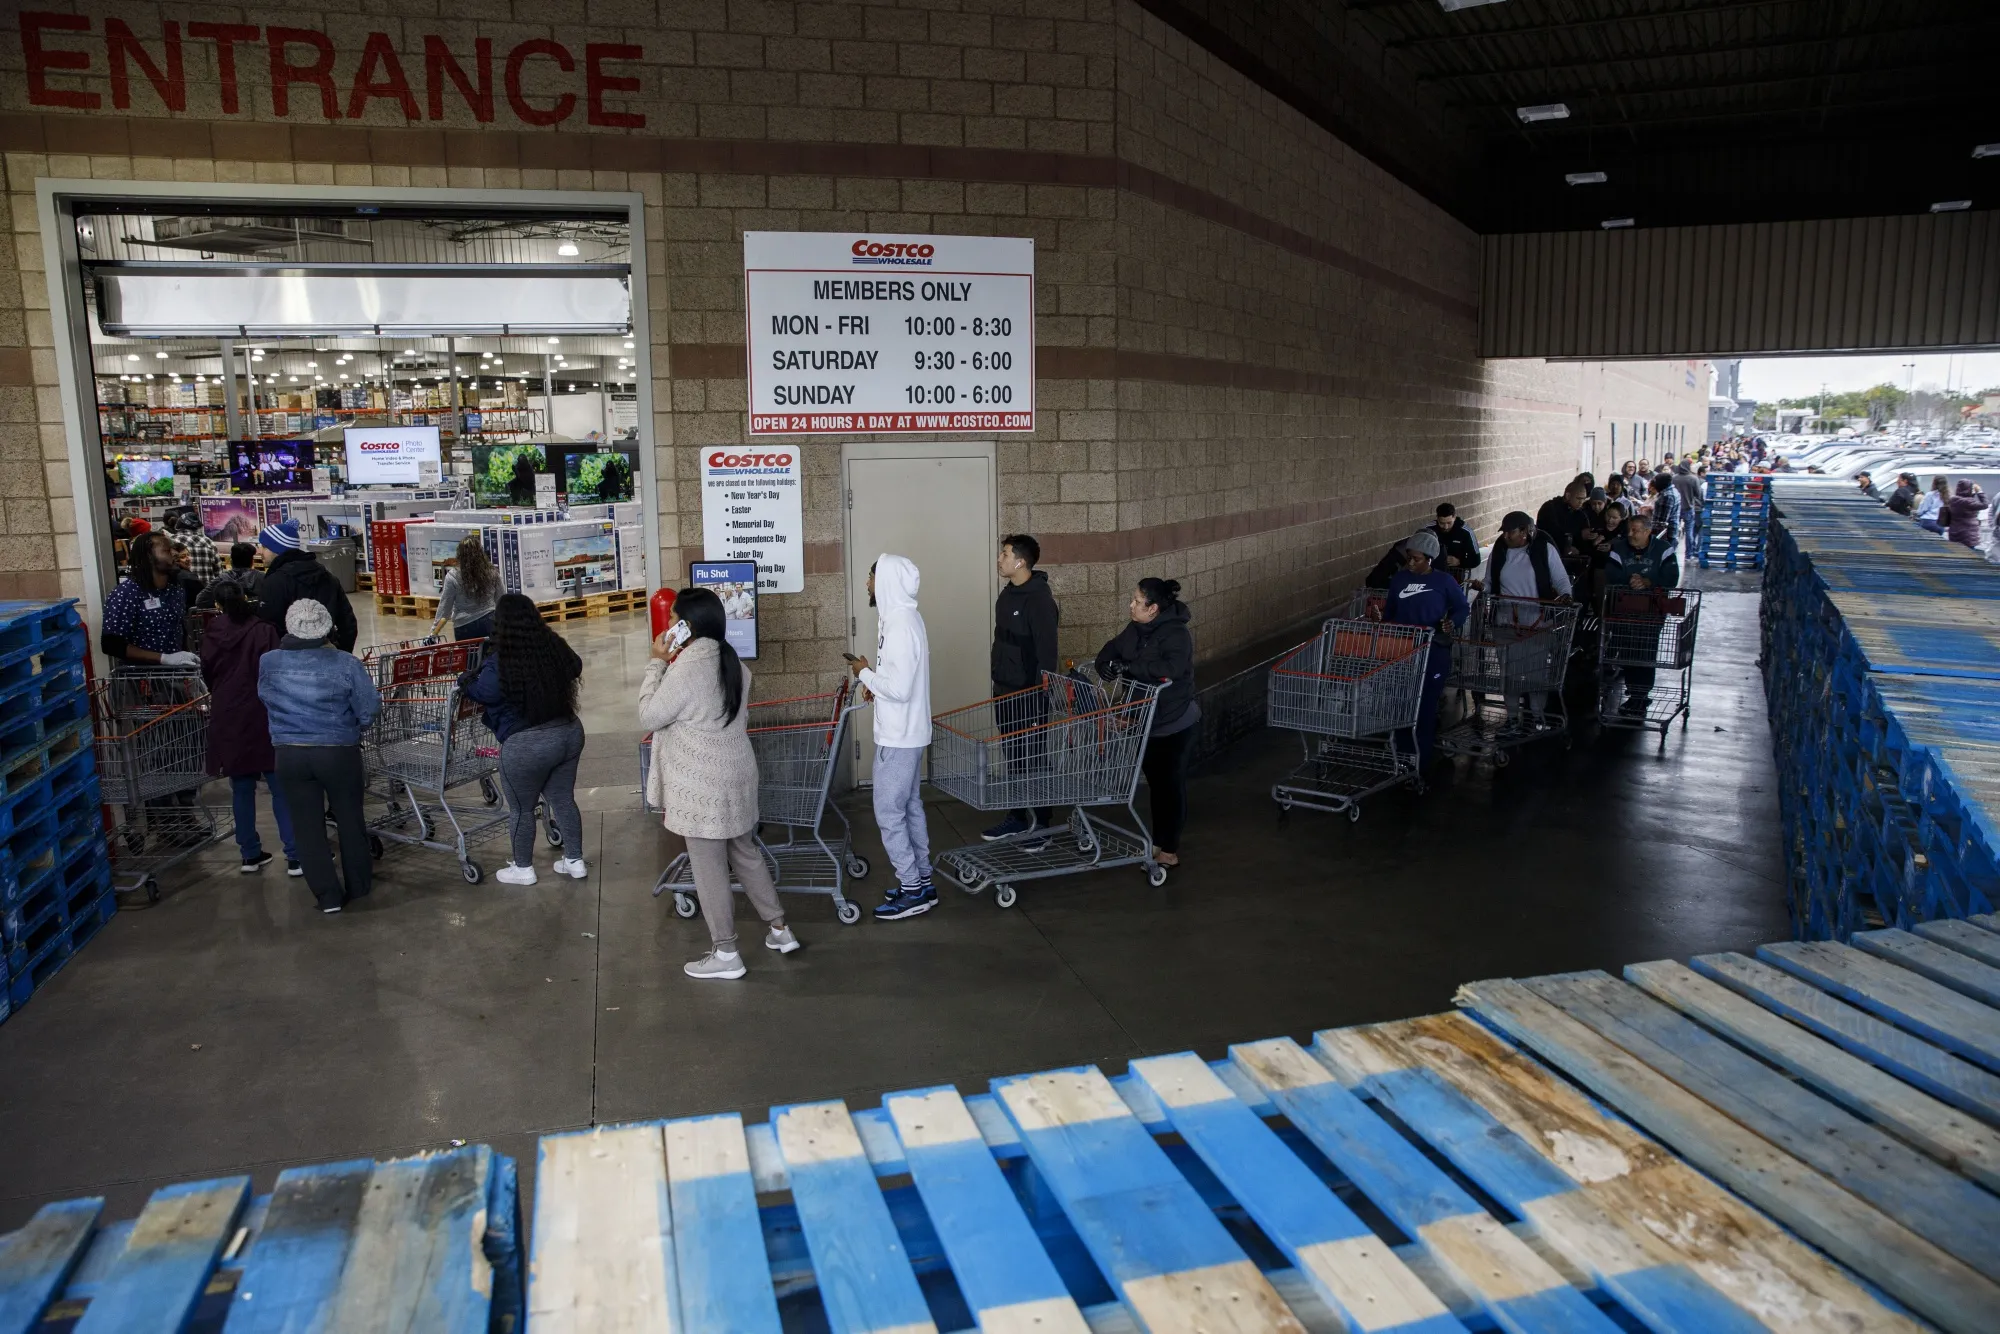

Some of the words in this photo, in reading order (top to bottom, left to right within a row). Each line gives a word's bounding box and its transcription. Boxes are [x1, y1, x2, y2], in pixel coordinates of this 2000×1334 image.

[20, 11, 647, 129] ENTRANCE
[851, 239, 935, 258] COSTCO
[876, 257, 932, 266] WHOLESALE
[814, 280, 915, 301] MEMBERS
[921, 282, 972, 302] ONLY
[772, 315, 819, 335] MON
[838, 315, 869, 335] FRI
[905, 316, 955, 336] 10:00
[972, 317, 1012, 337] 8:30
[772, 350, 878, 371] SATURDAY
[914, 351, 955, 370] 9:30
[972, 351, 1012, 370] 6:00
[773, 385, 855, 405] SUNDAY
[905, 385, 955, 404] 10:00
[972, 385, 1012, 404] 6:00
[753, 417, 788, 431] OPEN
[791, 417, 807, 430] 24
[811, 416, 853, 430] HOURS
[856, 416, 866, 429] A
[869, 416, 893, 429] DAY
[897, 415, 912, 429] AT
[915, 414, 1031, 429] WWW.COSTCO.COM
[360, 441, 400, 450] COSTCO
[708, 452, 793, 468] COSTCO
[732, 467, 790, 475] WHOLESALE
[725, 479, 740, 487] closed
[747, 479, 755, 487] the
[756, 479, 776, 488] following
[731, 491, 745, 500] New
[747, 491, 767, 500] Year's
[768, 491, 780, 501] Day
[731, 506, 751, 514] Easter
[732, 520, 762, 529] Memorial
[763, 520, 775, 529] Day
[732, 535, 774, 545] Independence
[775, 534, 787, 544] Day
[733, 550, 751, 559] Labor
[752, 550, 764, 559] Day
[774, 564, 785, 573] Day
[696, 569, 709, 579] Flu
[711, 569, 729, 579] Shot
[767, 579, 778, 588] Day
[1404, 583, 1427, 592] NIKE
